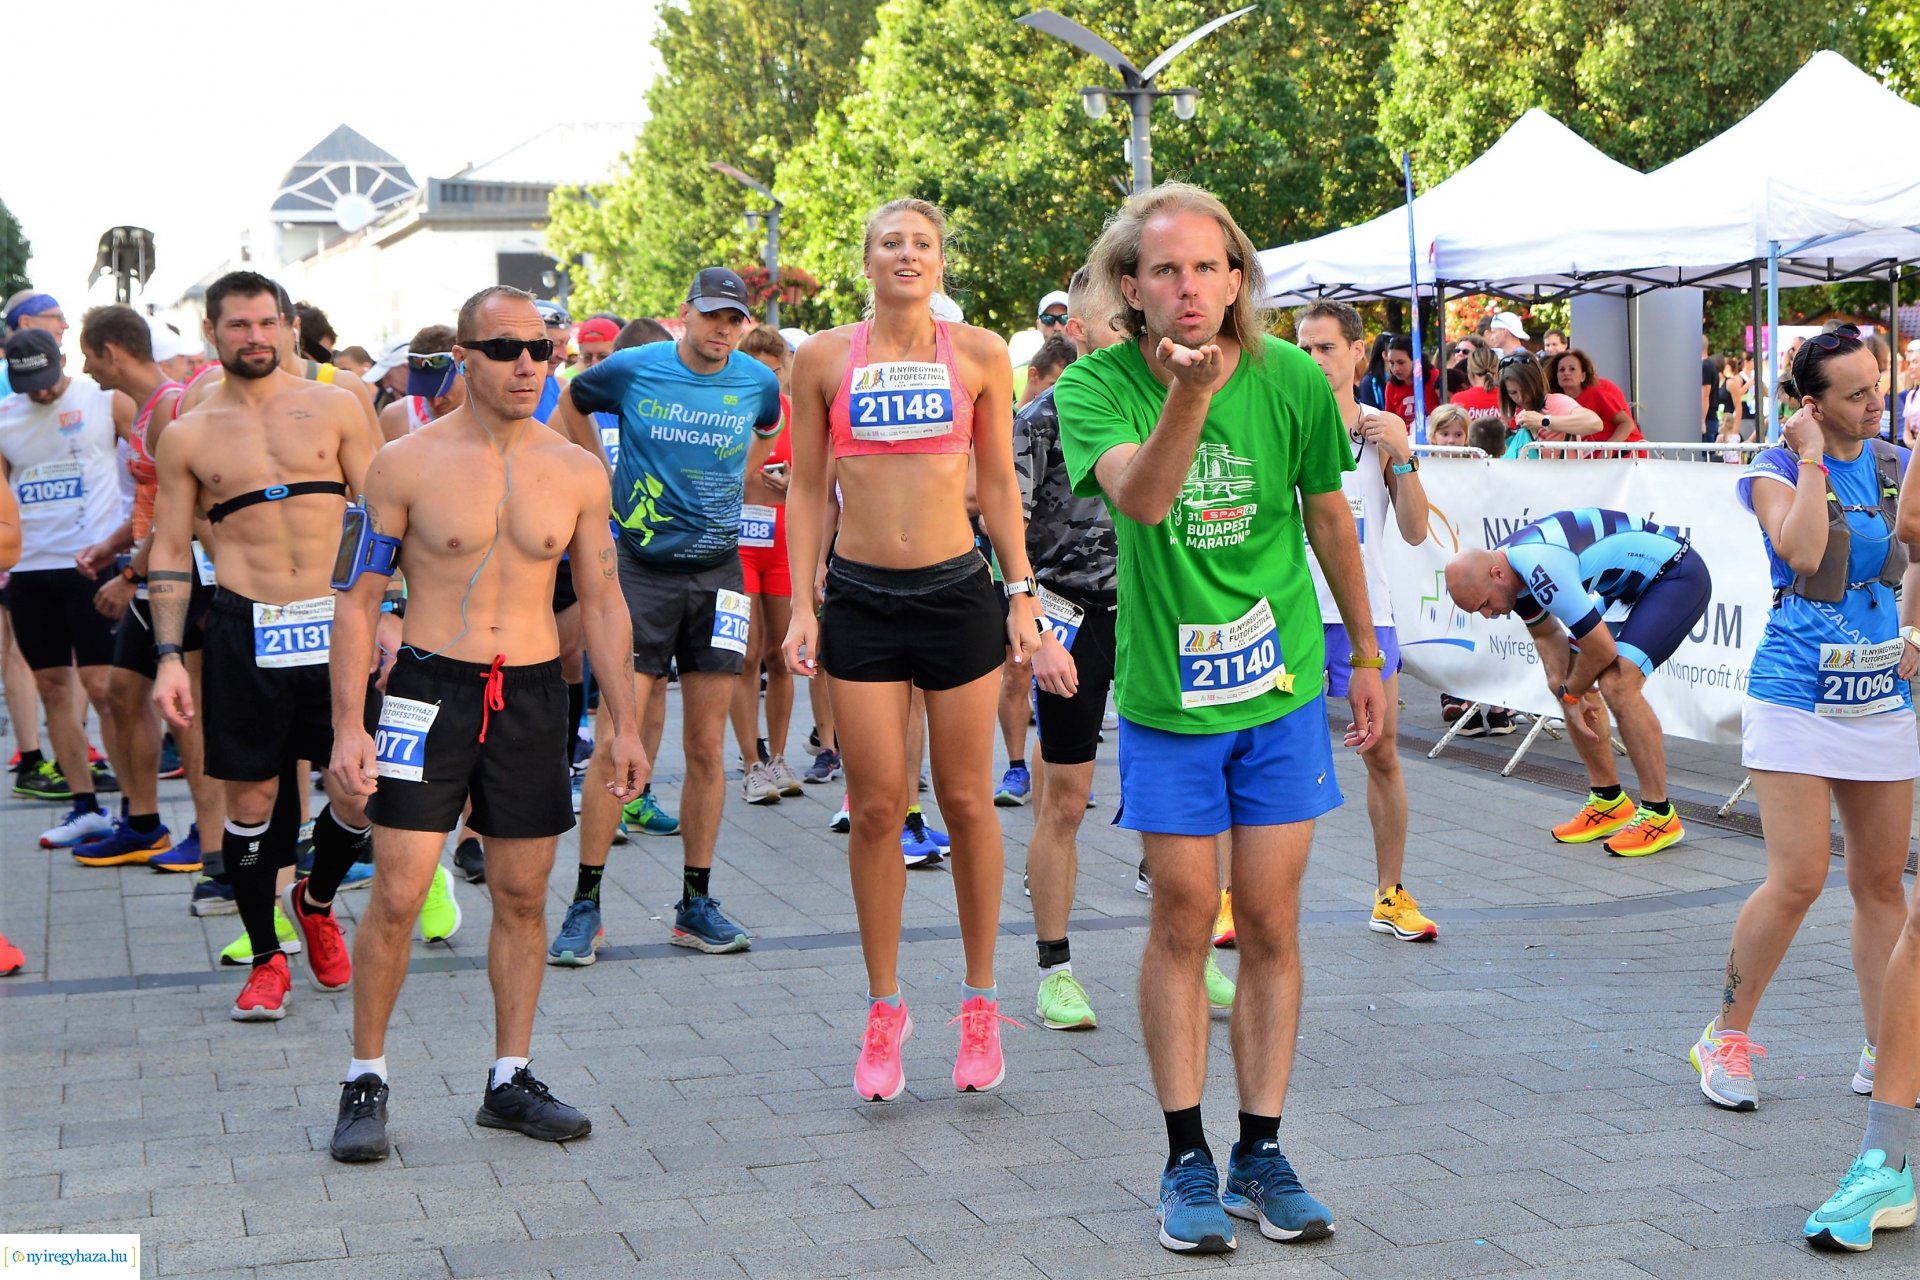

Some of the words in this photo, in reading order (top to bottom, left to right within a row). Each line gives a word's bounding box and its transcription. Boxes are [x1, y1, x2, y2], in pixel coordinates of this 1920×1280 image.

[858, 393, 944, 423] 21148
[651, 425, 733, 448] HUNGARY
[714, 440, 745, 461] Team
[21, 479, 79, 502] 21097
[1187, 517, 1252, 536] BUDAPEST
[1188, 512, 1202, 521] 31.
[1209, 508, 1244, 519] SPAR
[1530, 564, 1559, 605] 575
[263, 624, 330, 653] 21131
[1192, 639, 1275, 687] 21140
[1667, 657, 1731, 689] Nonprofit
[1823, 669, 1894, 701] 21096
